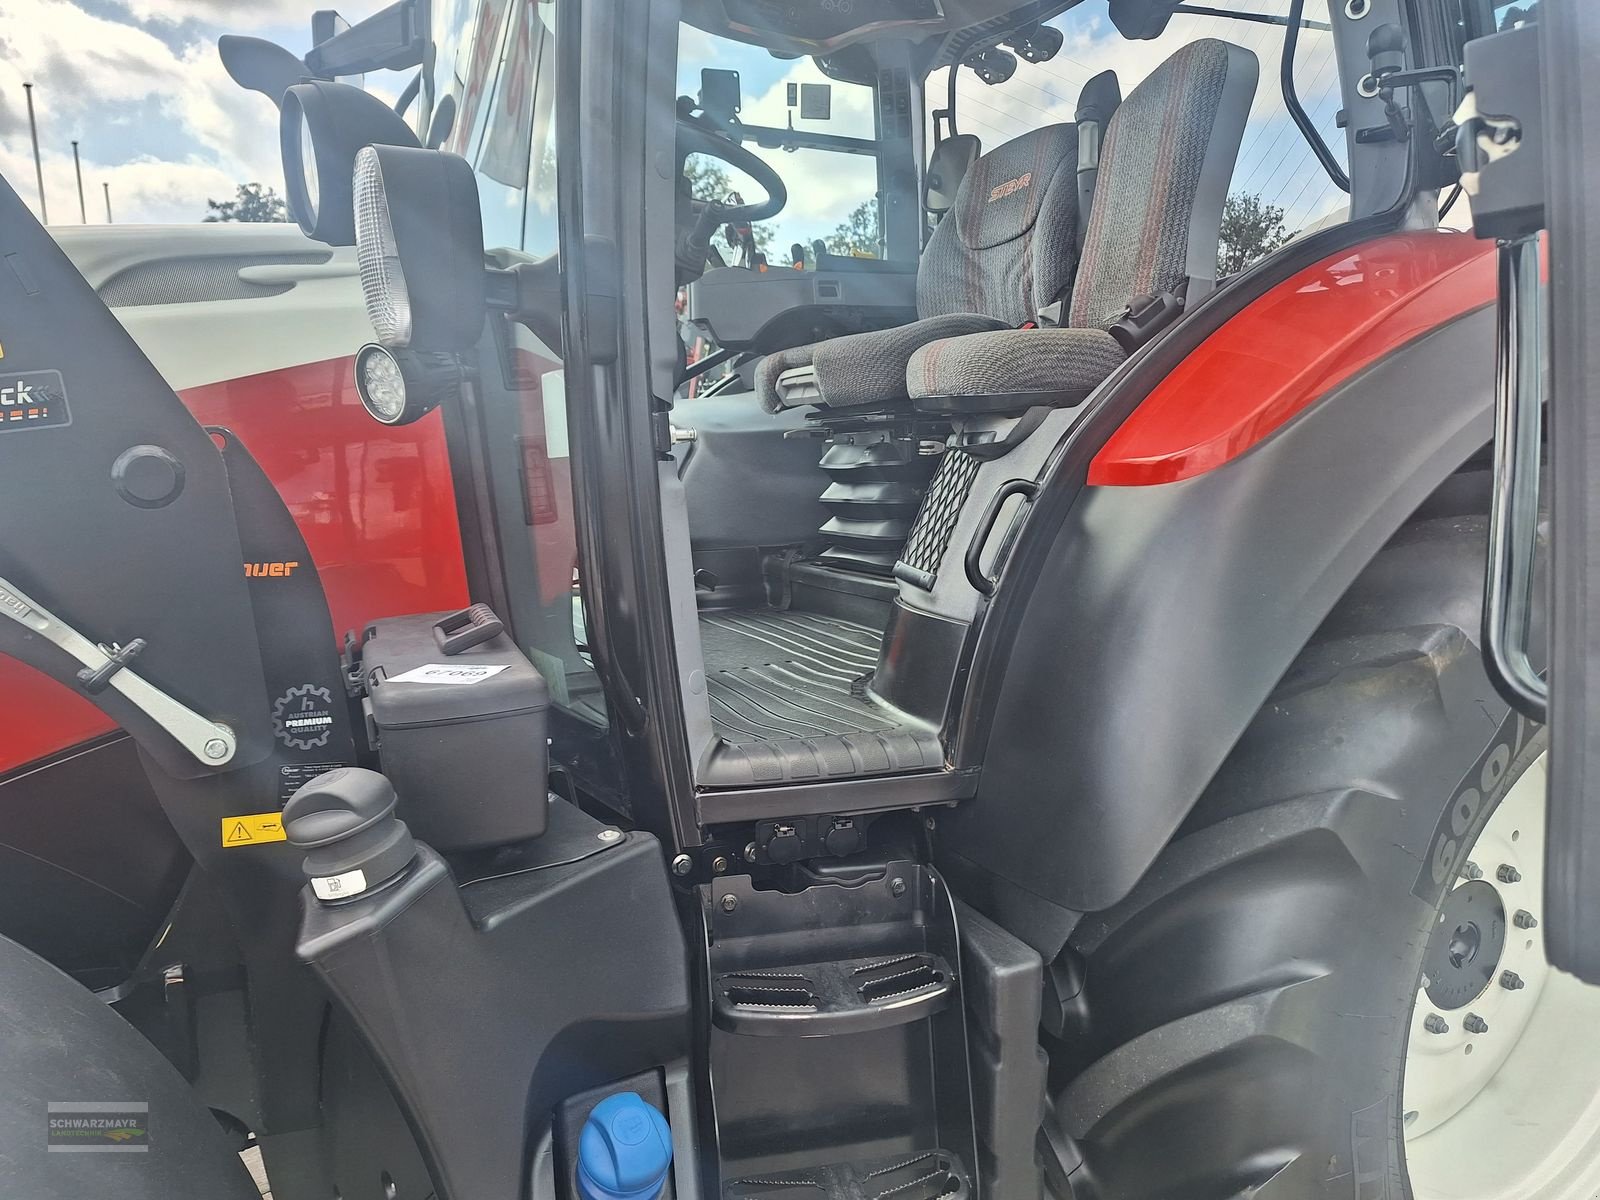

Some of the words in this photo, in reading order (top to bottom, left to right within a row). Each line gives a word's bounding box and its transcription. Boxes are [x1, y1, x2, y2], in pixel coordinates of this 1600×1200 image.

[287, 710, 329, 719] AUSTRIAN
[285, 716, 332, 727] PREMIUM
[290, 724, 328, 733] QUALITY
[1431, 711, 1536, 885] 600/
